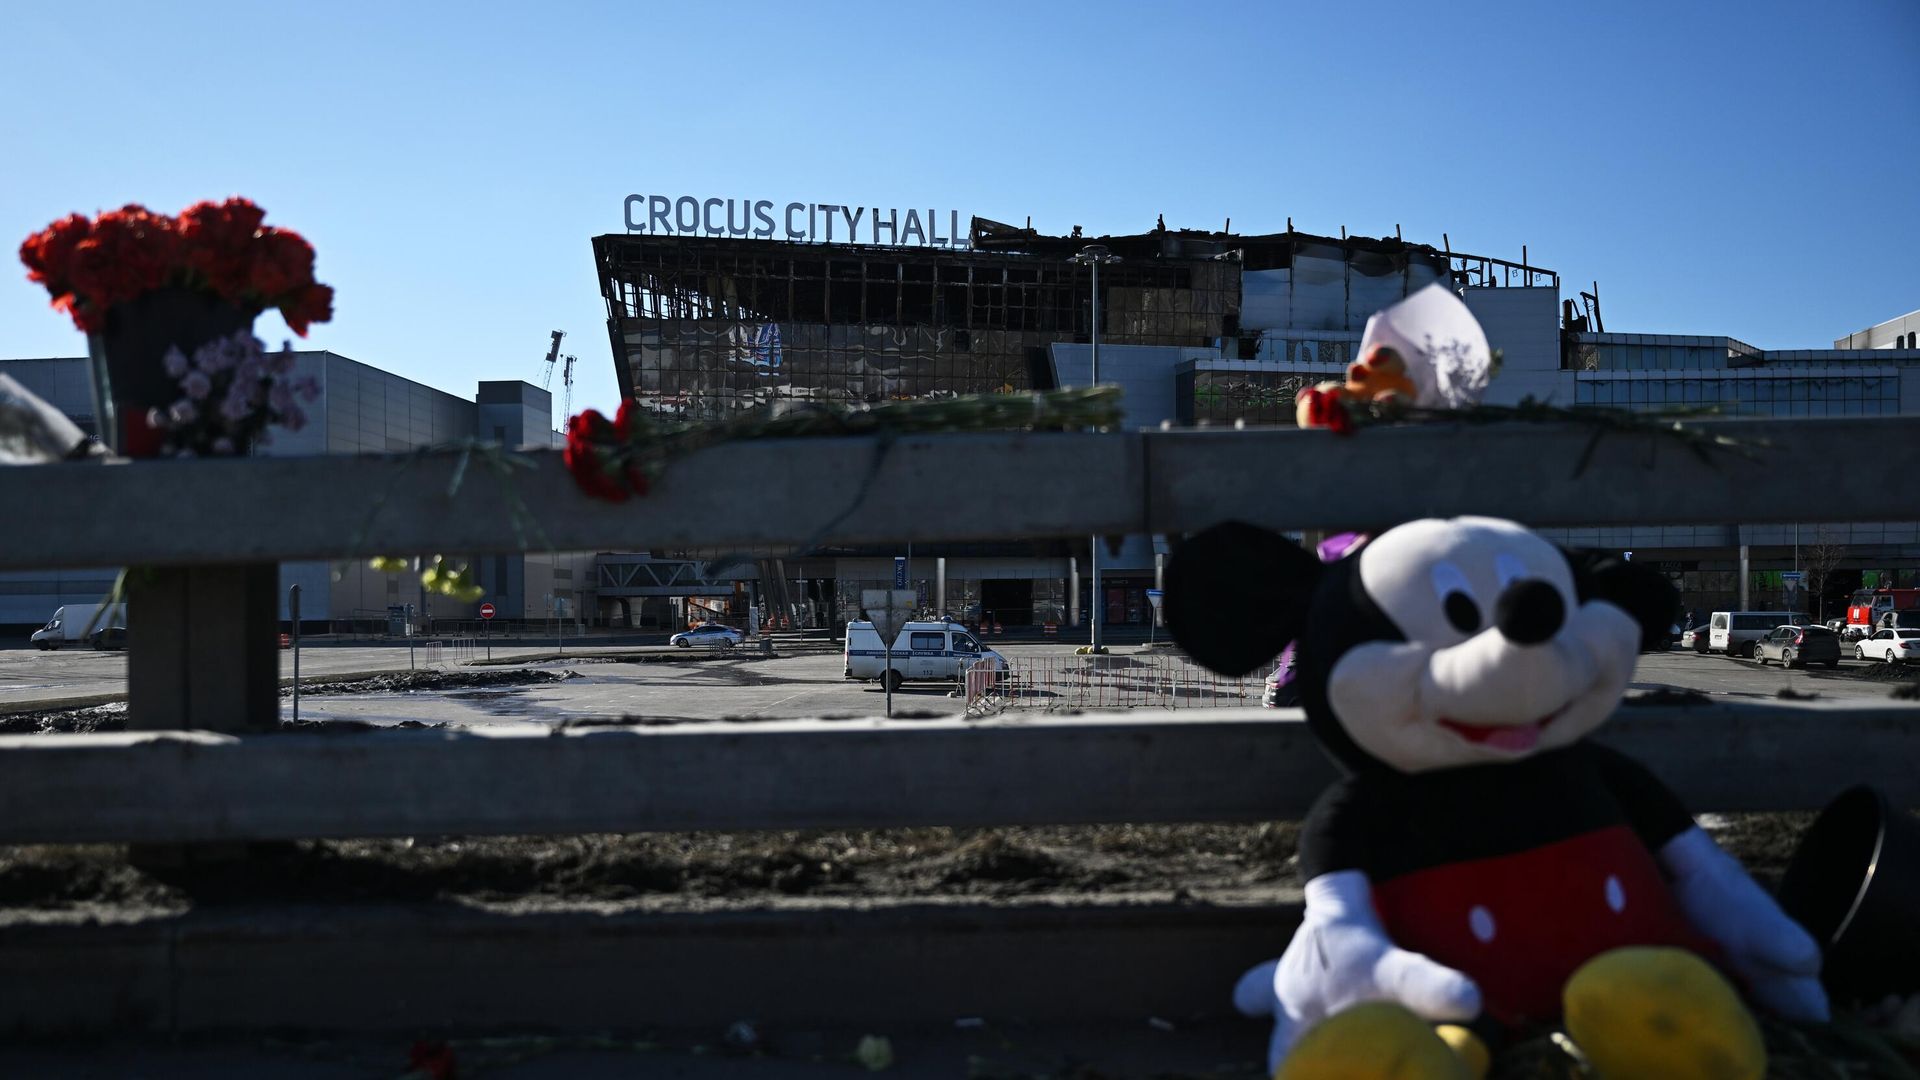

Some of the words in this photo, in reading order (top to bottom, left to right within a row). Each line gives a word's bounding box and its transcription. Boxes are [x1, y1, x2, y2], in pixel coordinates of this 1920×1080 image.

[623, 193, 776, 236] CROCUS
[785, 202, 865, 242] CITY
[872, 207, 973, 249] HALL
